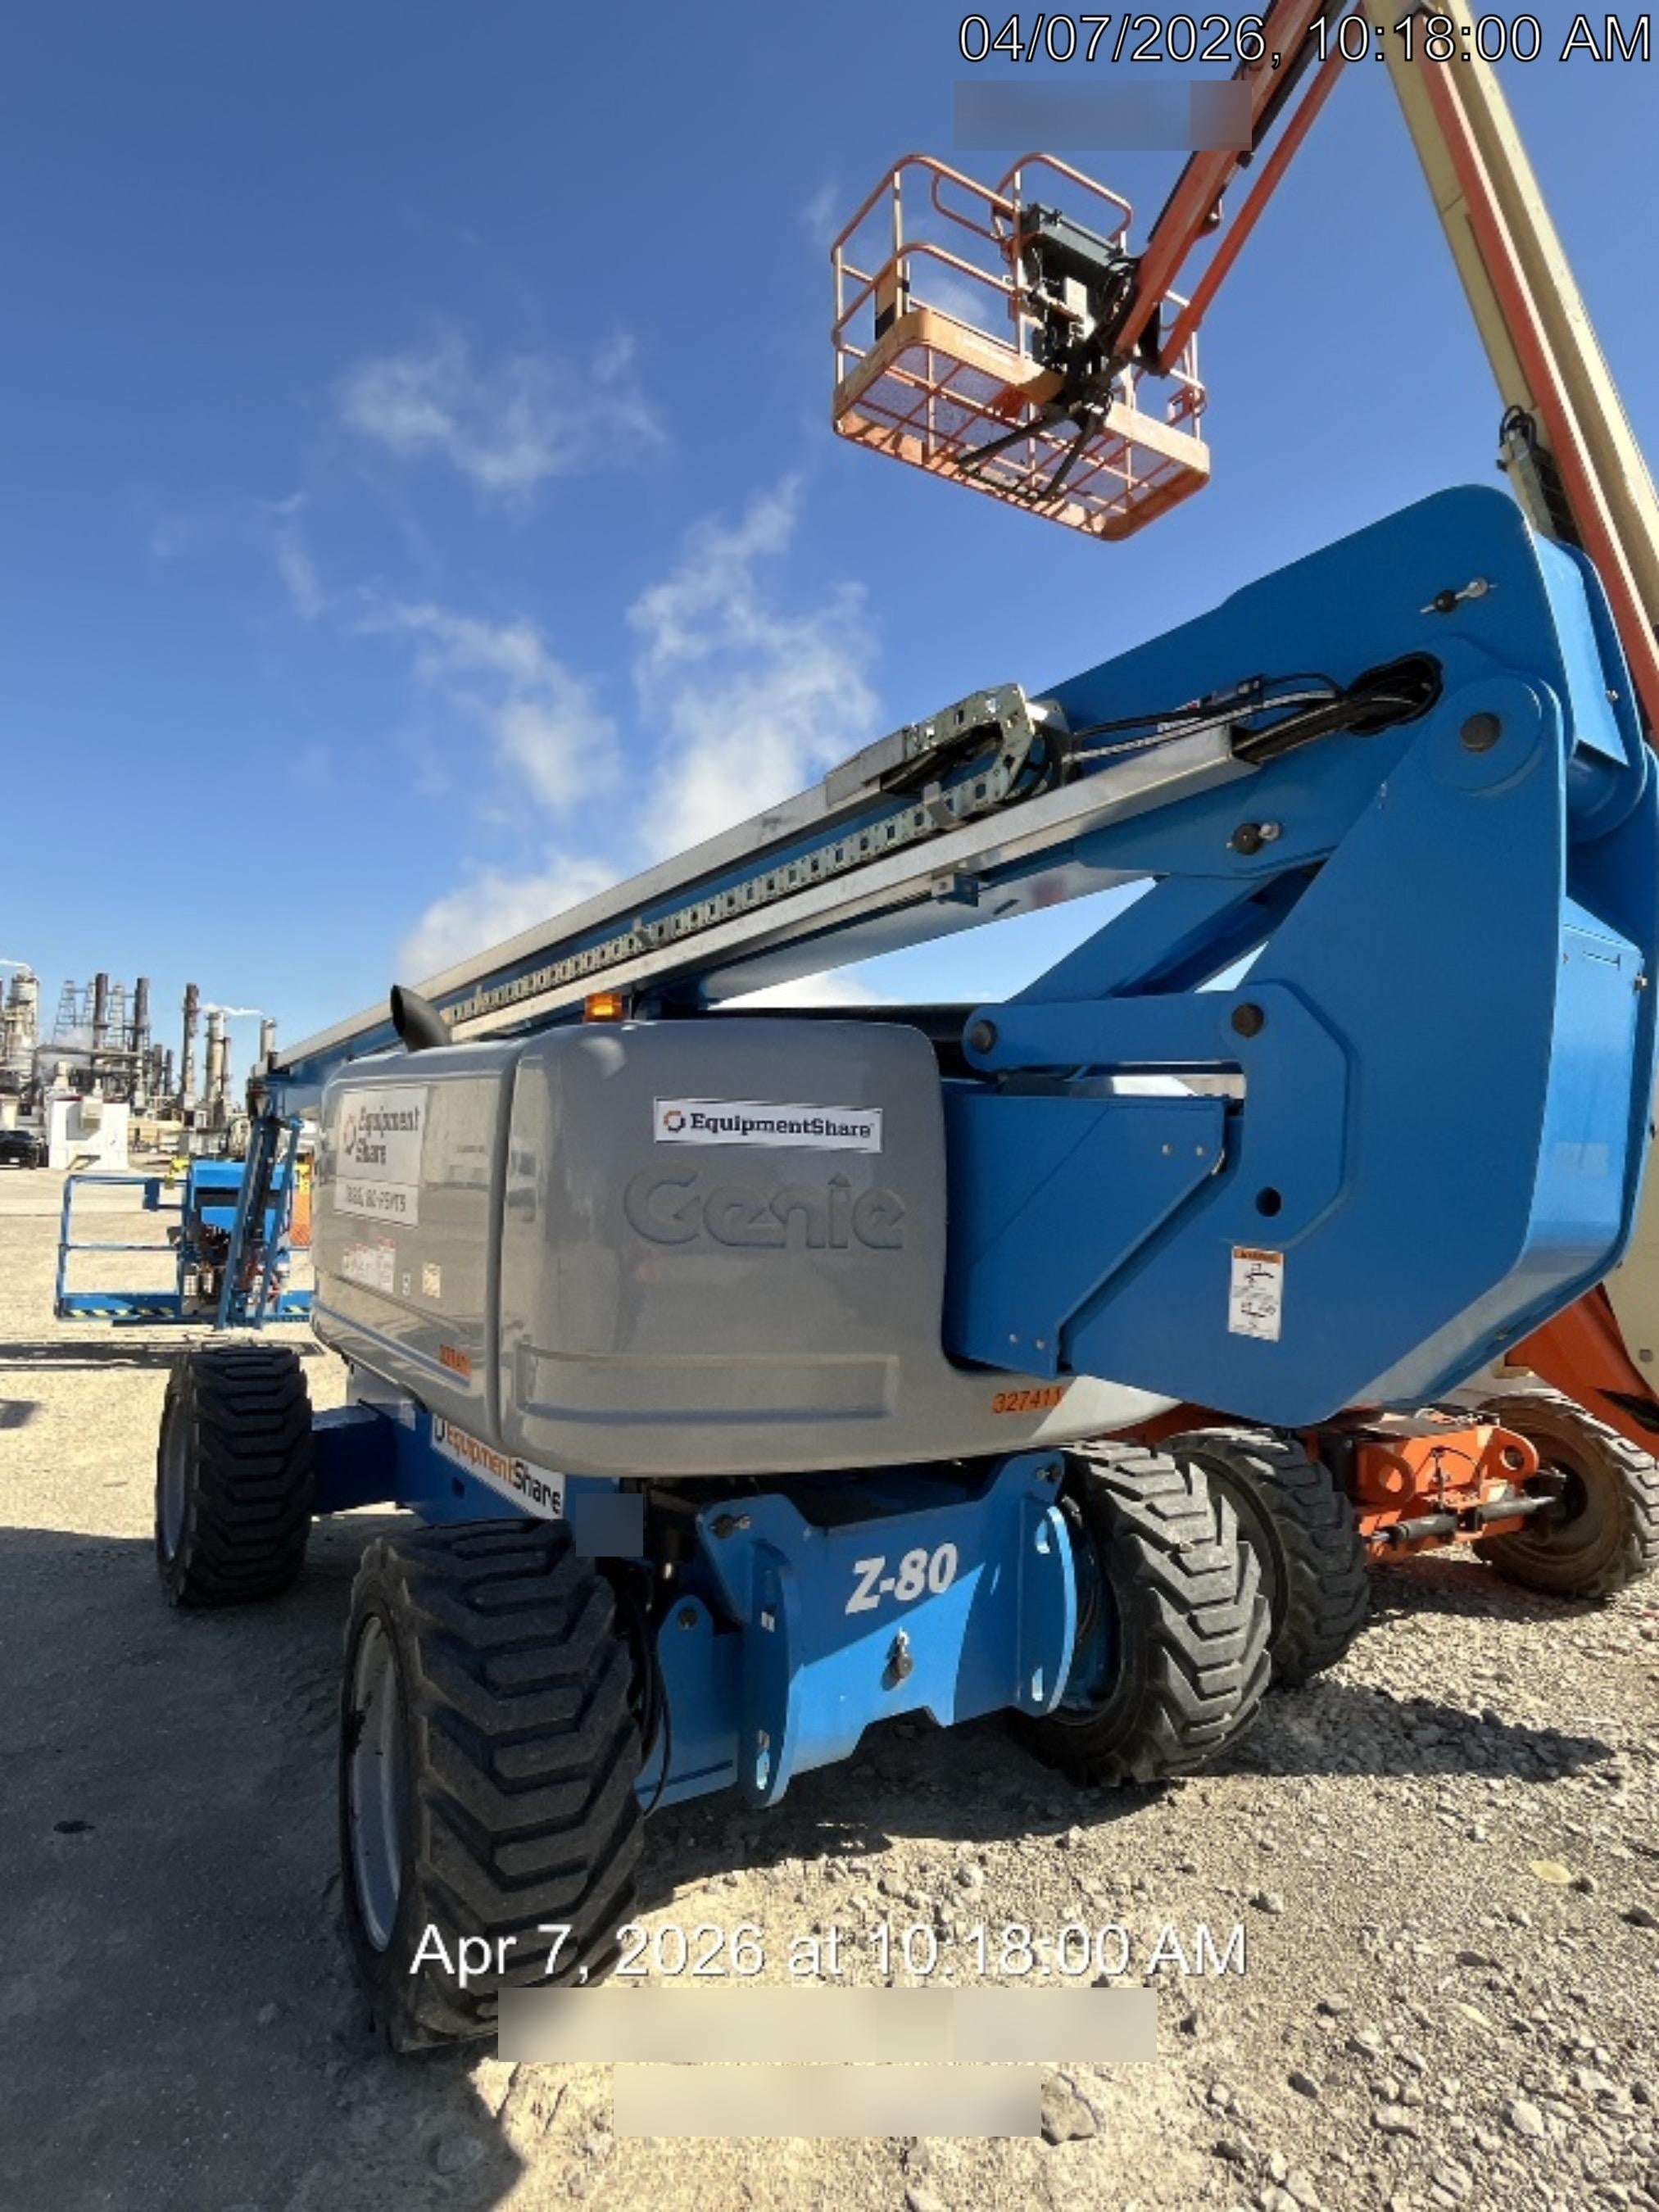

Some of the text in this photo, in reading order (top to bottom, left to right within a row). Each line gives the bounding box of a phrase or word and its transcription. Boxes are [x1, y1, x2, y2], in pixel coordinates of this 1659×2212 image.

[358, 1105, 420, 1138] Equipment
[690, 1113, 872, 1138] EquipmentShare
[356, 1138, 387, 1165] Share
[624, 1163, 905, 1249] Genie
[991, 1387, 1063, 1414] 327411
[845, 1542, 959, 1616] Z-80
